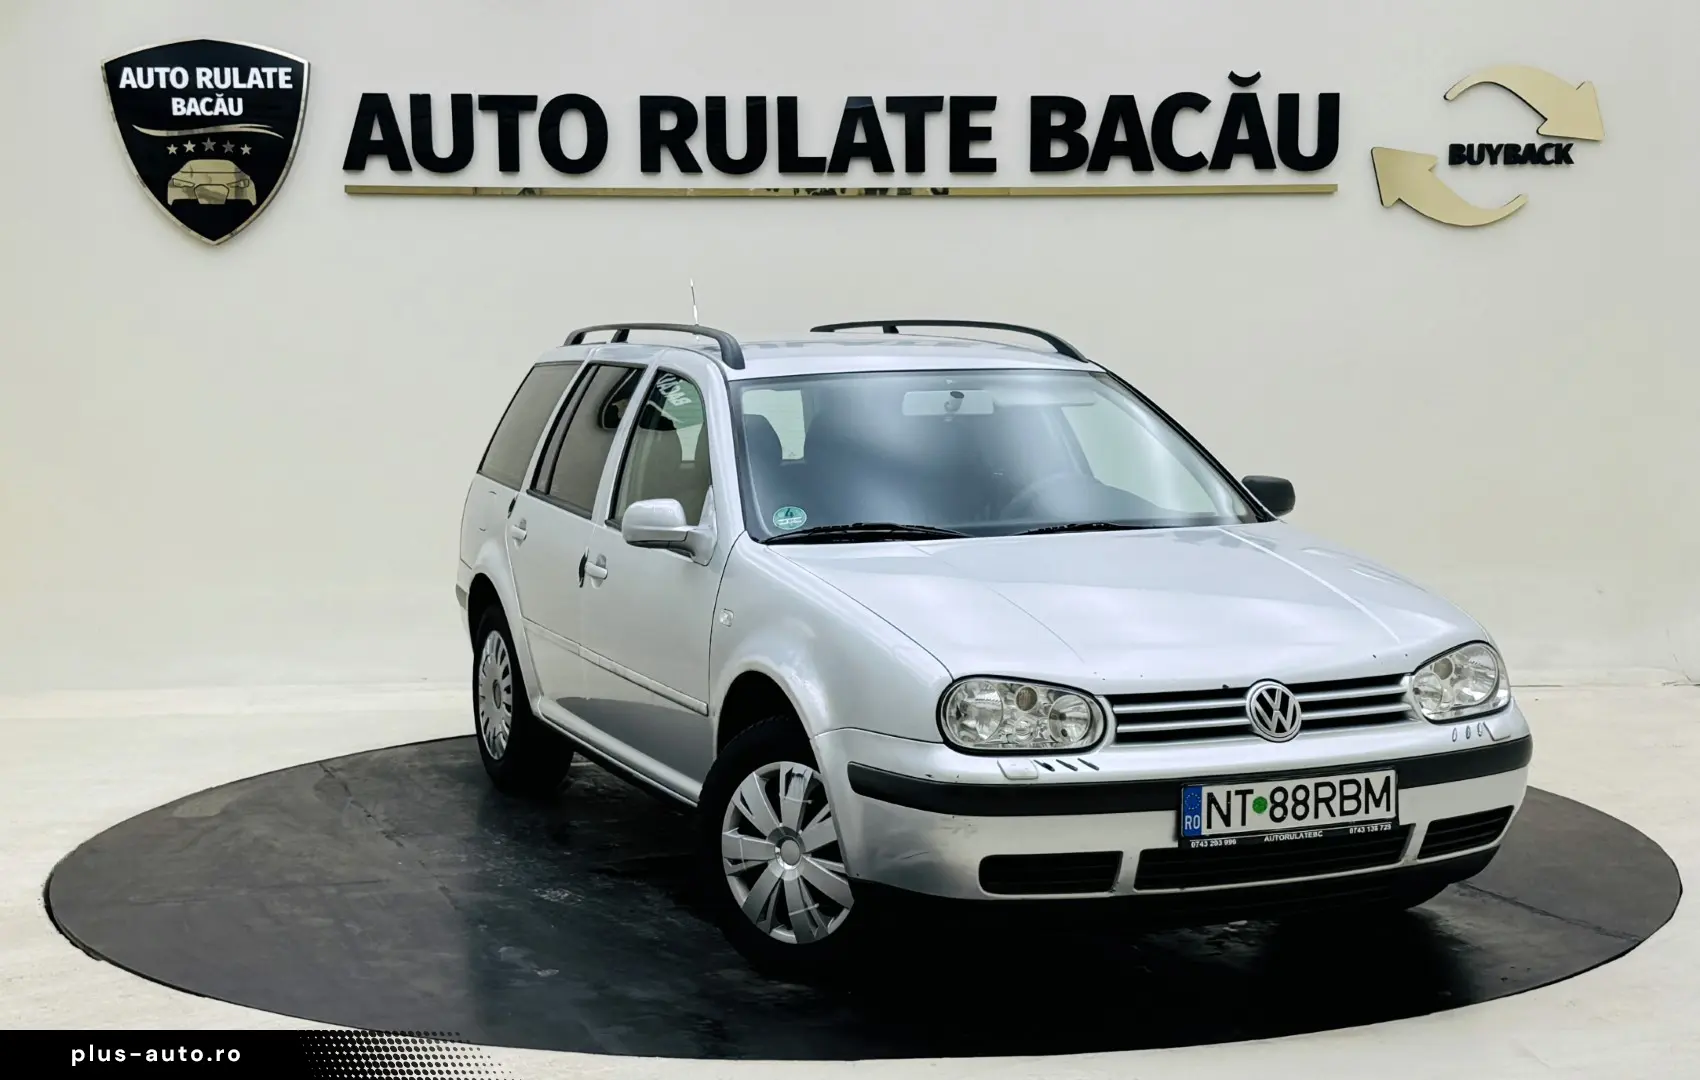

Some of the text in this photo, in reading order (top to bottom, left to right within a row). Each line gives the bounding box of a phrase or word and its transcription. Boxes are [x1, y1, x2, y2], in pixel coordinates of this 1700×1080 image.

[119, 67, 293, 89] AUTO RULATE
[171, 93, 243, 116] BACĂU
[342, 70, 1340, 174] AUTO RULATE BACĂU
[1447, 142, 1575, 167] BUYBACK
[1250, 684, 1299, 738] VW
[1206, 775, 1391, 830] NT 88RBM
[1184, 815, 1200, 830] RO
[1191, 840, 1208, 848] 0743
